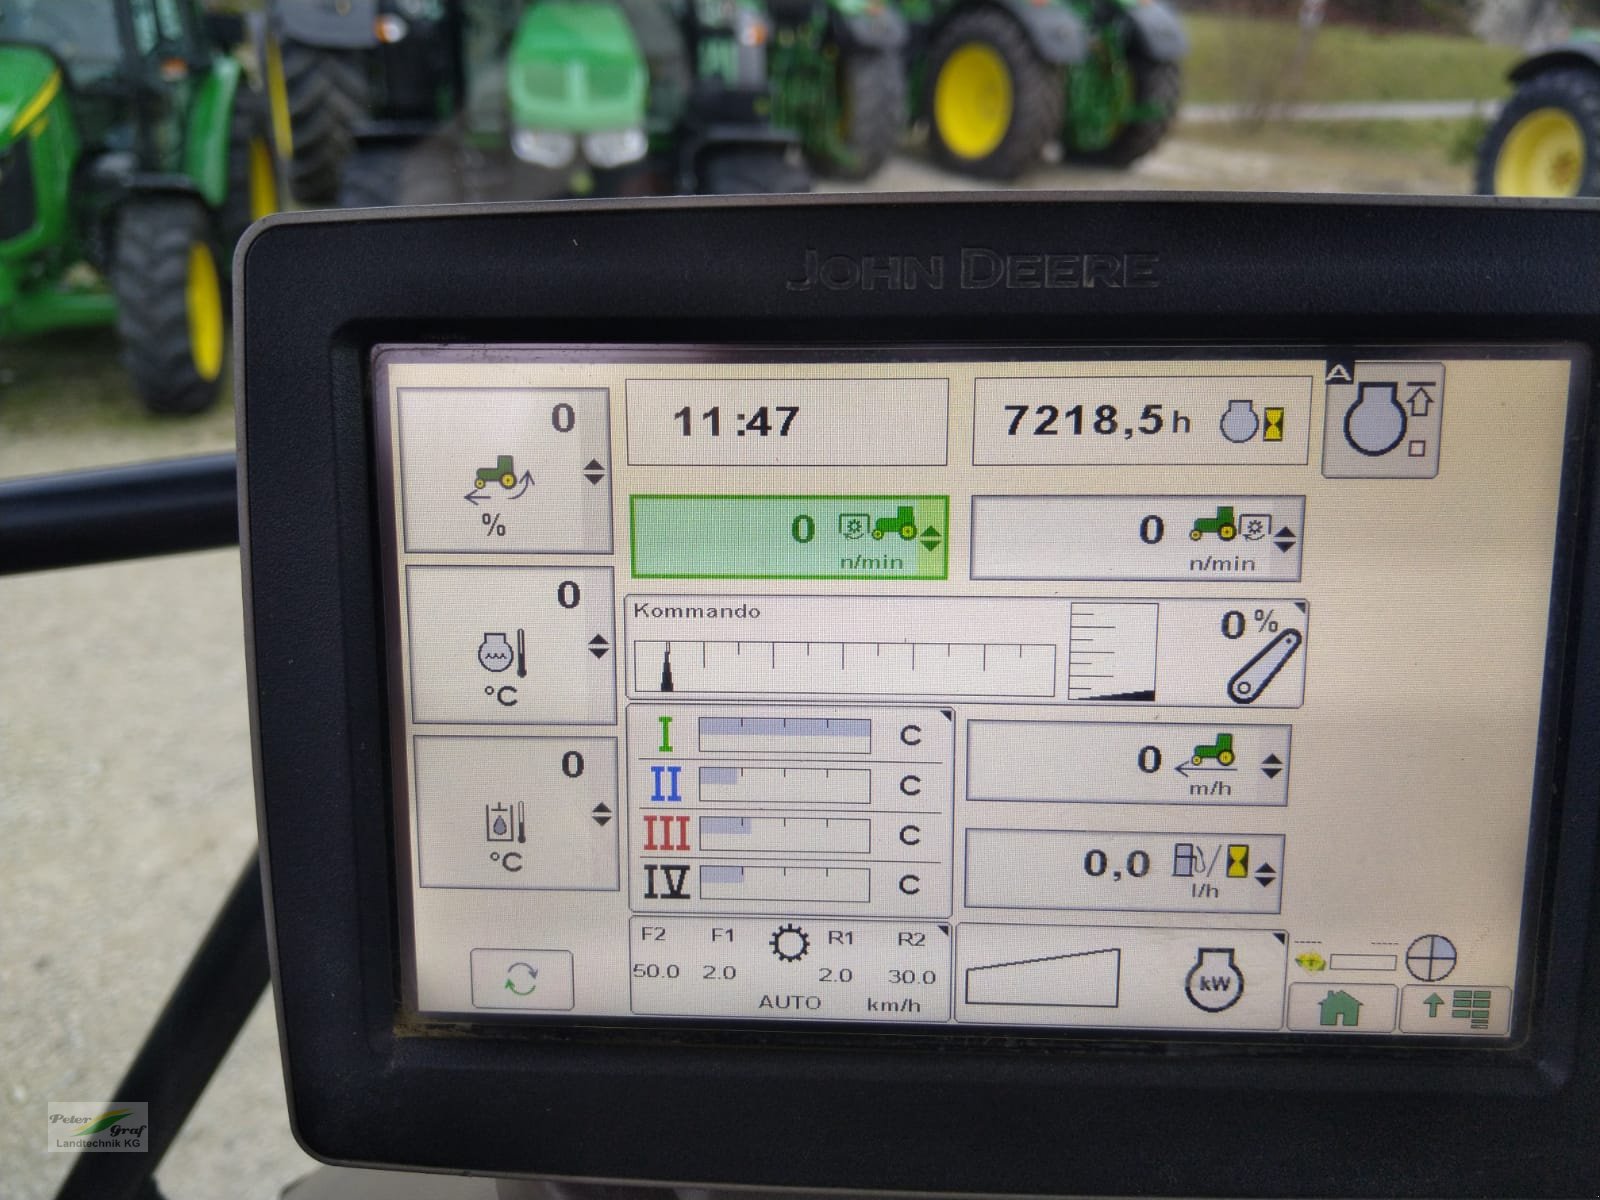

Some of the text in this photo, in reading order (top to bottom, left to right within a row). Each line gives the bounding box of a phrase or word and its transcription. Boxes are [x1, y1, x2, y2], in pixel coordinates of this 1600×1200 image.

[786, 248, 1160, 291] JOHN DEERE
[552, 403, 575, 432] 0
[674, 407, 800, 437] 11:47
[482, 513, 506, 536] %
[792, 515, 815, 543] 0
[1140, 515, 1164, 544] 0
[840, 554, 903, 570] n/min
[1190, 556, 1255, 572] n/min
[557, 581, 581, 609] 0
[634, 604, 761, 620] Kommando
[485, 686, 517, 706] °C
[659, 717, 673, 752] I
[901, 725, 922, 746] C
[561, 751, 584, 778] 0
[1138, 746, 1161, 772] 0
[650, 766, 681, 801] II
[900, 775, 921, 796] C
[1190, 781, 1232, 797] m/h
[643, 816, 690, 850] III
[900, 825, 921, 845] C
[490, 852, 523, 872] °C
[1083, 850, 1150, 881] 0,0
[644, 865, 690, 899] IV
[900, 875, 921, 895] C
[642, 927, 926, 947] F2 F1 R1 R2
[634, 964, 936, 984] 50.0 2.0 2.0 30.0
[1200, 977, 1231, 992] kW
[759, 995, 921, 1013] AUTO km/h
